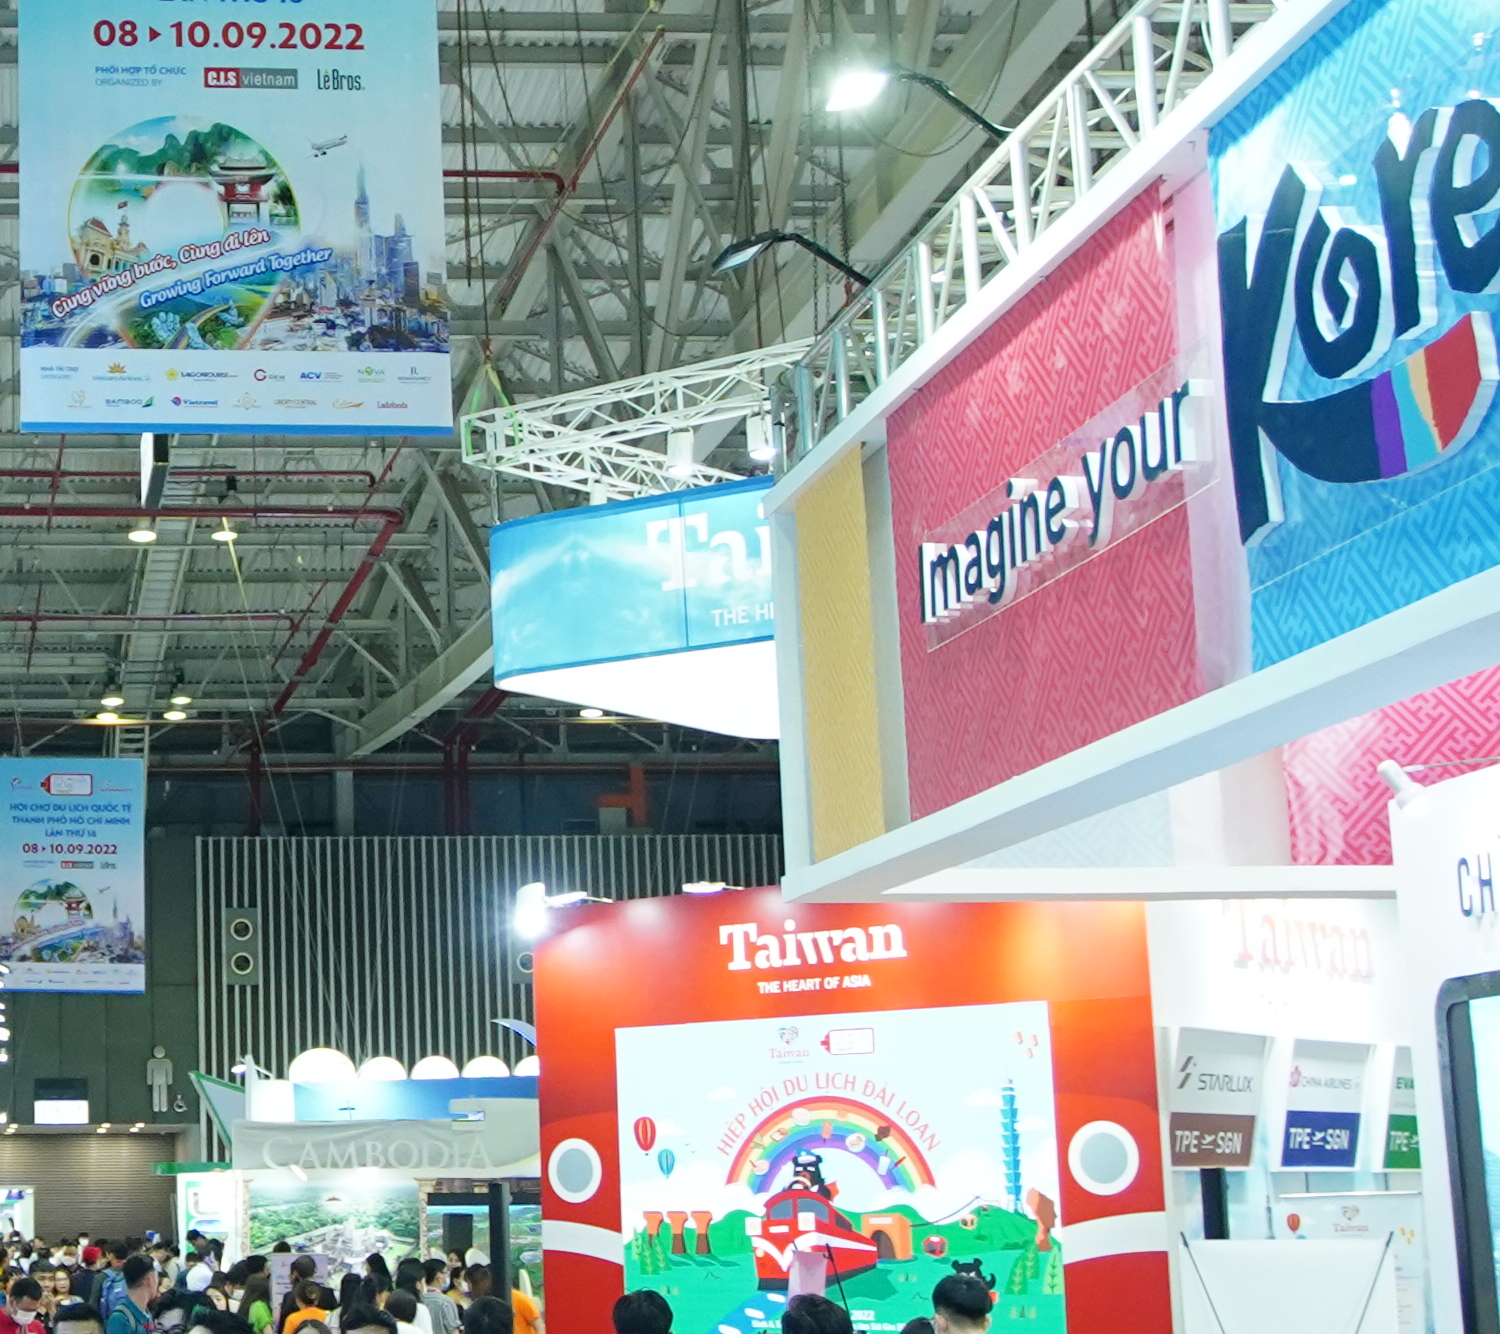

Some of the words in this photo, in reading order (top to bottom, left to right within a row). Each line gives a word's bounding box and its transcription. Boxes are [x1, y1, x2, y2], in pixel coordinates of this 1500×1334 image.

[93, 19, 138, 47] 08
[170, 20, 366, 51] 10.09.2022
[240, 71, 296, 88] vietnam
[51, 287, 93, 318] Cùng
[178, 238, 221, 264] Cùng
[223, 233, 245, 254] đi
[244, 228, 271, 249] lên
[139, 277, 202, 309] Growing
[203, 260, 266, 287] Forward
[267, 247, 333, 273] Together
[918, 480, 1066, 624] Imagine
[1082, 385, 1200, 547] your
[646, 503, 772, 592] Tai
[711, 607, 750, 628] THE
[22, 843, 39, 854] 08
[49, 843, 118, 855] 10.09.2022
[719, 919, 908, 971] Taiwan
[757, 980, 782, 994] THE
[783, 978, 821, 993] HEART
[823, 976, 840, 990] OF
[842, 974, 872, 989] ASIA
[769, 1048, 810, 1059] Taiwan
[1197, 1073, 1254, 1093] STARLUX
[782, 1075, 808, 1097] DU
[815, 1072, 857, 1094] LỊCH
[896, 1100, 942, 1152] LOAN
[1175, 1130, 1200, 1154] TPE
[1215, 1131, 1243, 1154] SGN
[1288, 1127, 1312, 1150] TPE
[1325, 1128, 1350, 1150] SGN
[1389, 1130, 1410, 1153] TPE
[262, 1135, 495, 1170] CAMBODIA
